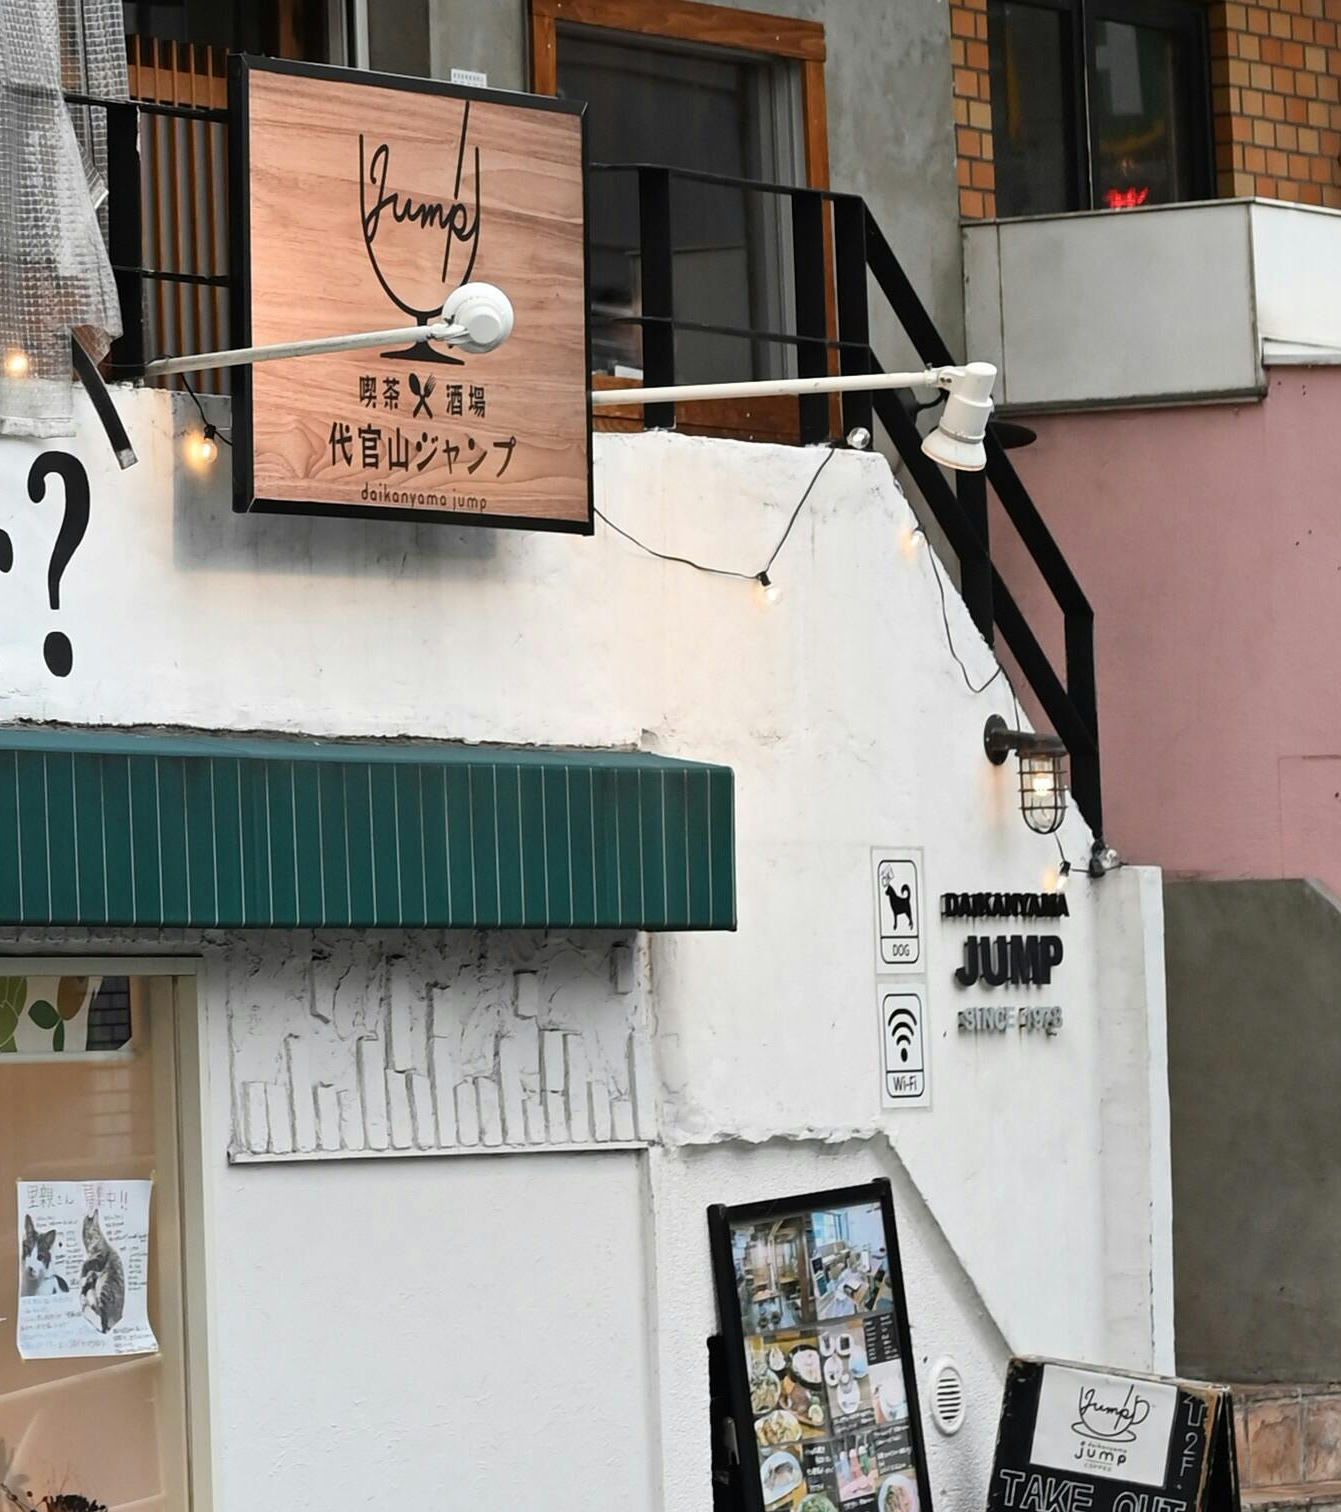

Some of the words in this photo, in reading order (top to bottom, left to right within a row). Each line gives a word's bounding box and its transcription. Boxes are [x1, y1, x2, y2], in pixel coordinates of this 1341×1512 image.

[362, 142, 479, 283] Jump
[359, 375, 400, 410] 喫茶
[445, 383, 487, 419] 酒場
[328, 422, 517, 478] 代官山ジャンプ
[361, 482, 448, 508] daikanyama
[452, 487, 488, 511] jump
[939, 892, 1070, 917] DAIKANYAMA
[892, 943, 910, 957] DOG
[954, 935, 1064, 987] JUMP
[961, 1006, 1015, 1032] SINCE
[893, 1075, 918, 1093] Wi-Fi
[1073, 1440, 1128, 1467] jump
